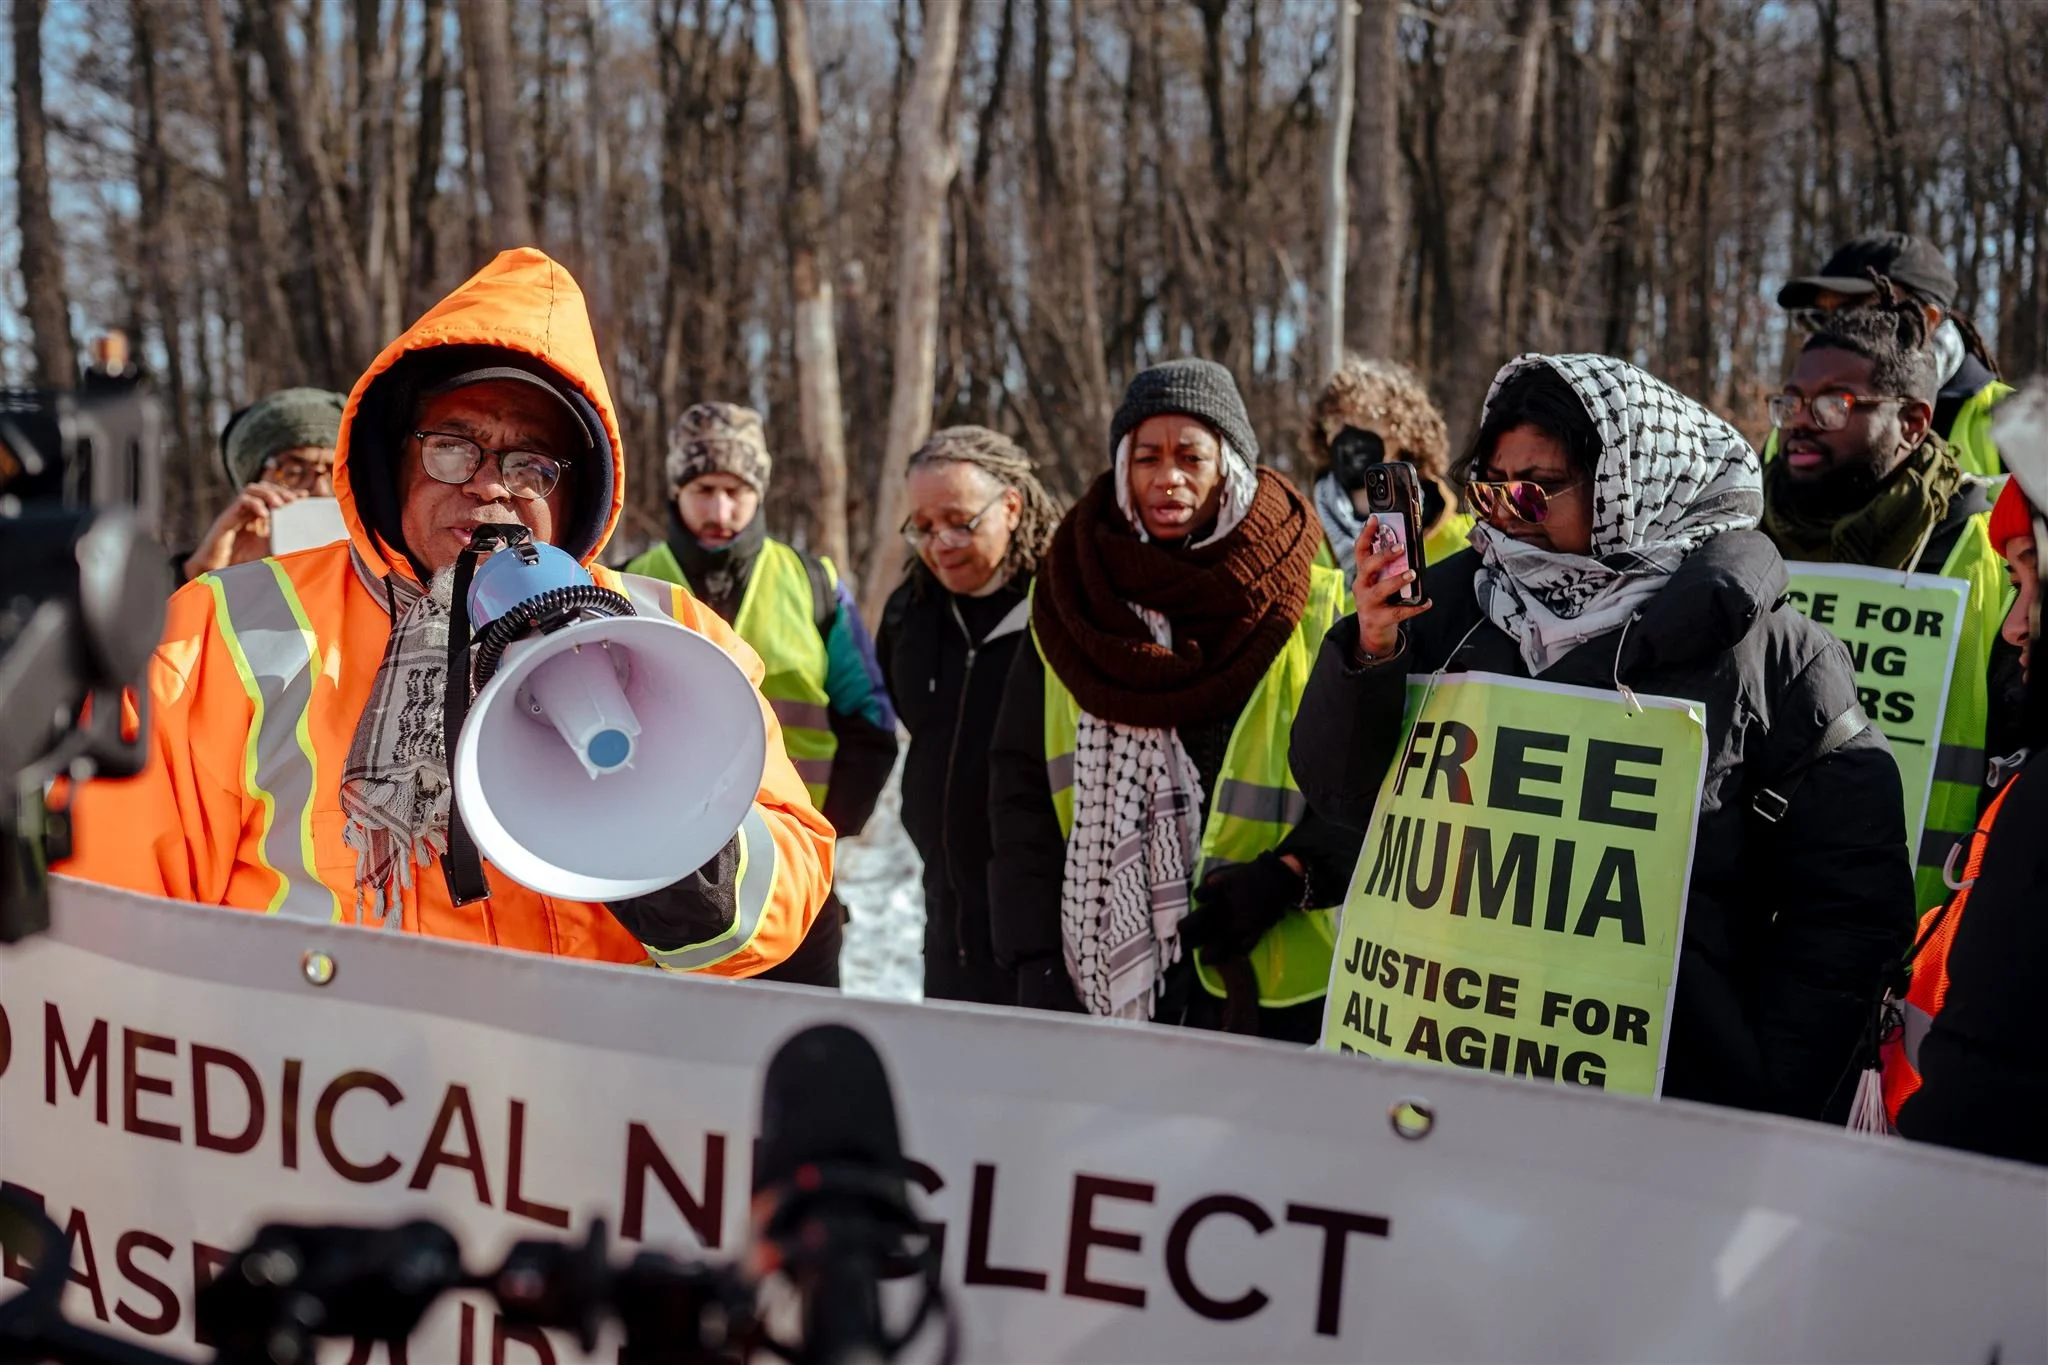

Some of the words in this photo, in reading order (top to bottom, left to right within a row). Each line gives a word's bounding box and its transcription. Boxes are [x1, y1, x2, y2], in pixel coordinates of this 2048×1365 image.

[1855, 602, 1945, 638] FOR
[1395, 720, 1664, 832] FREE
[1363, 813, 1647, 946] MUMIA
[1342, 990, 1393, 1047] ALL
[1403, 1015, 1607, 1092] AGING
[1344, 936, 1520, 1020] JUSTICE
[1540, 990, 1651, 1047] FOR
[43, 1001, 570, 1230] MEDICAL
[619, 1119, 1391, 1338] NLECT
